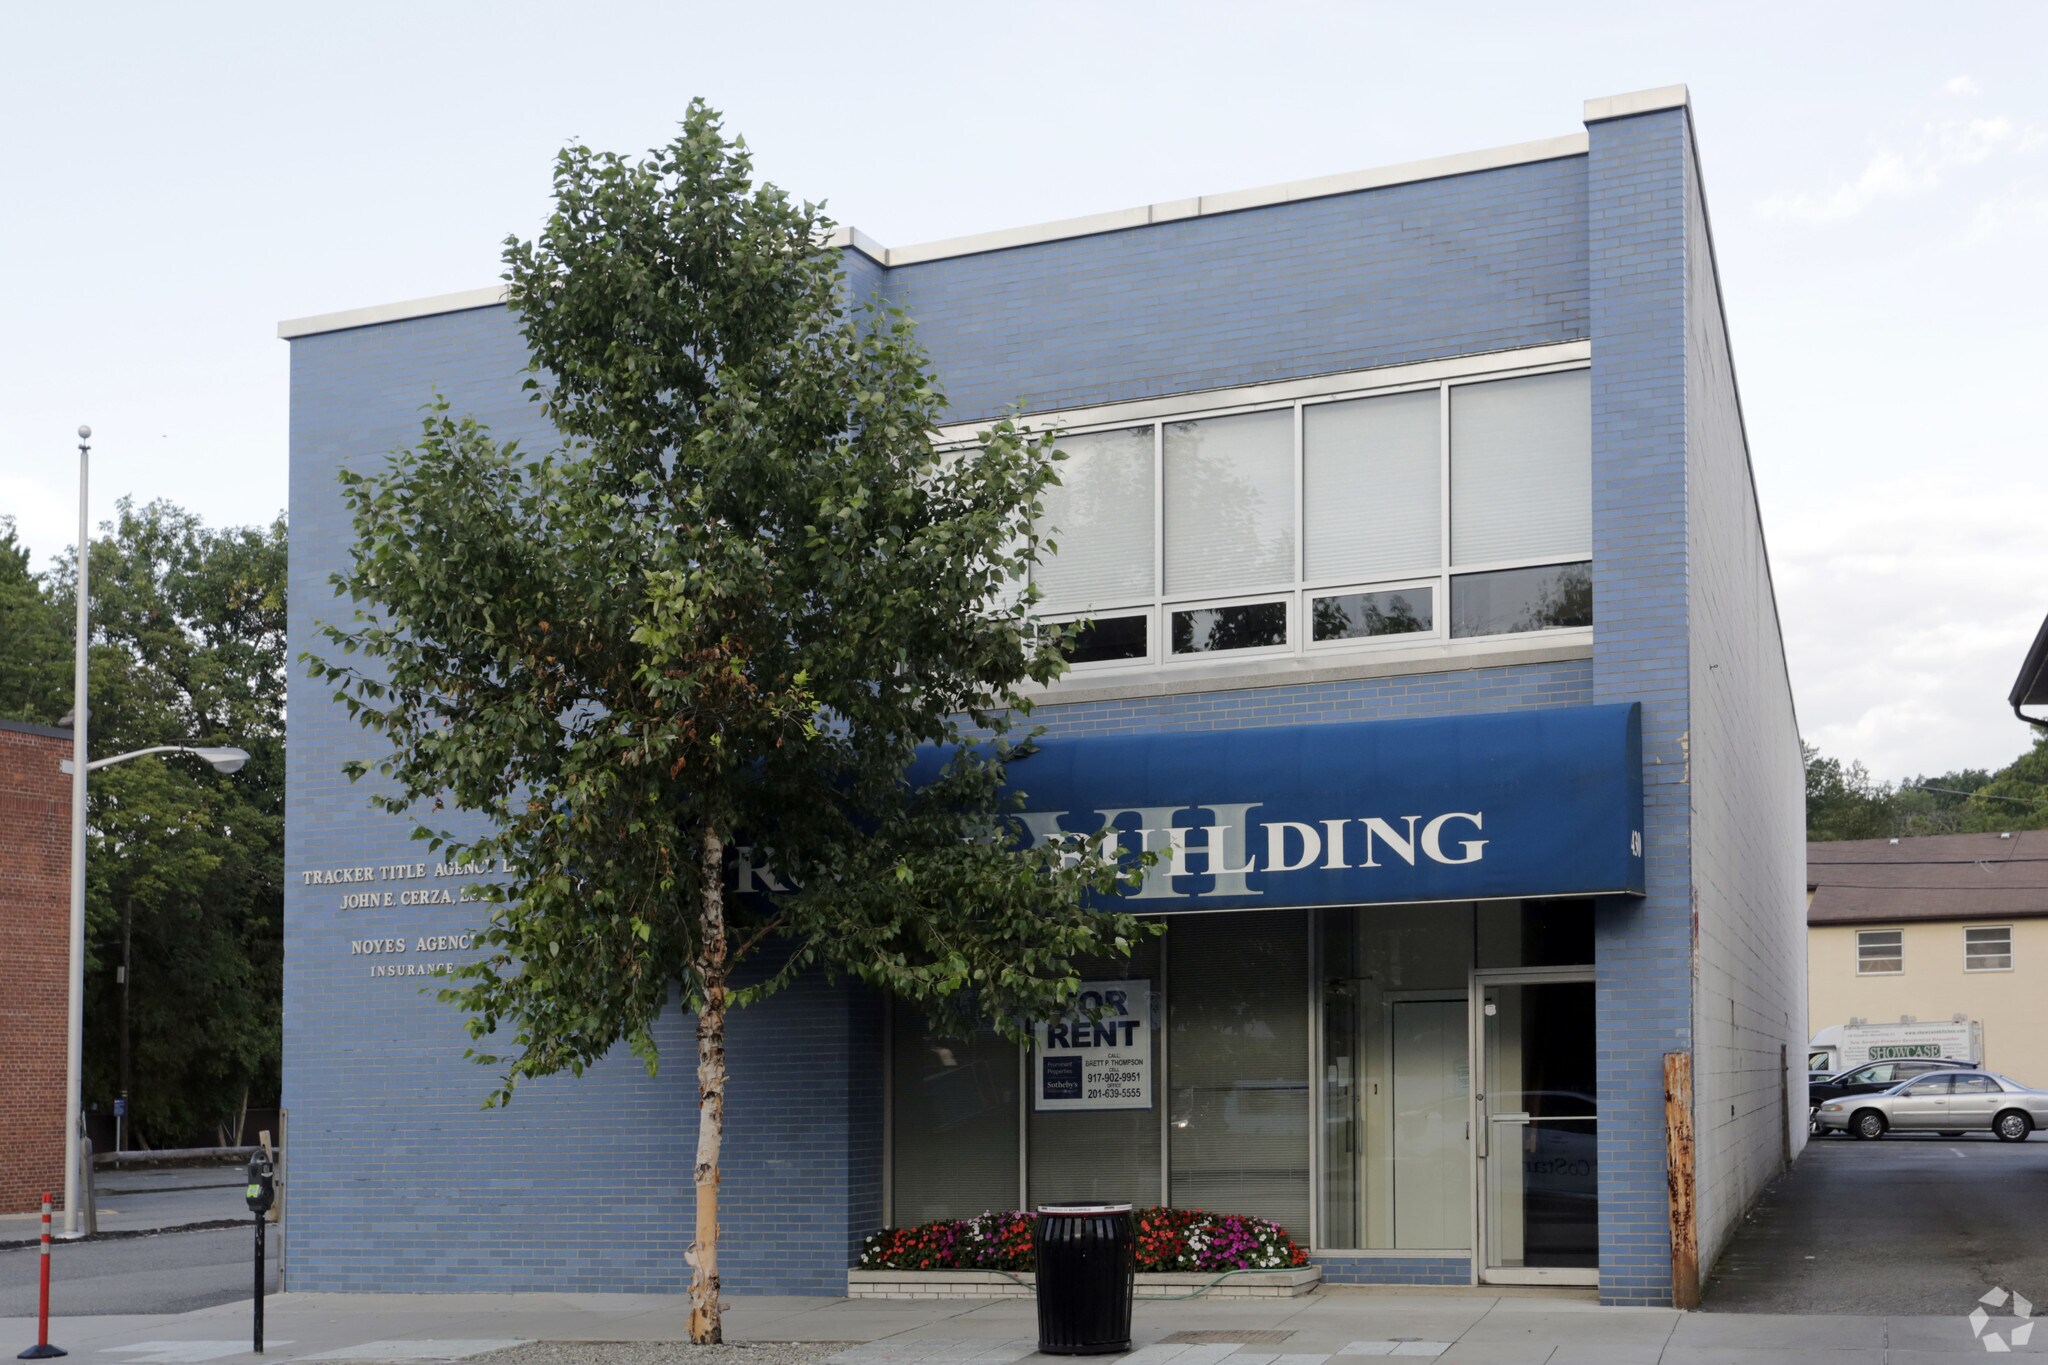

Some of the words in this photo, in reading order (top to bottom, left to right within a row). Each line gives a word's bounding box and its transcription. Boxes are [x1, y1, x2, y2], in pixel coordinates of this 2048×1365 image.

[1631, 829, 1642, 858] 430
[302, 866, 374, 885] TRACKER
[380, 863, 426, 880] TITLE
[340, 893, 380, 910] JOHN
[383, 892, 397, 907] E.
[400, 888, 456, 906] CERZA,
[352, 938, 406, 955] NOYES
[370, 962, 454, 977] INSURANCE
[1047, 1020, 1141, 1048] RENT
[1869, 1045, 1940, 1060] SHOWCASE
[1085, 1059, 1104, 1067] BRETT
[1111, 1058, 1144, 1066] THOMPSON
[1047, 1080, 1078, 1090] Sotheby's
[1087, 1072, 1140, 1083] 917-902-9951
[1087, 1088, 1141, 1099] 201-639-5555
